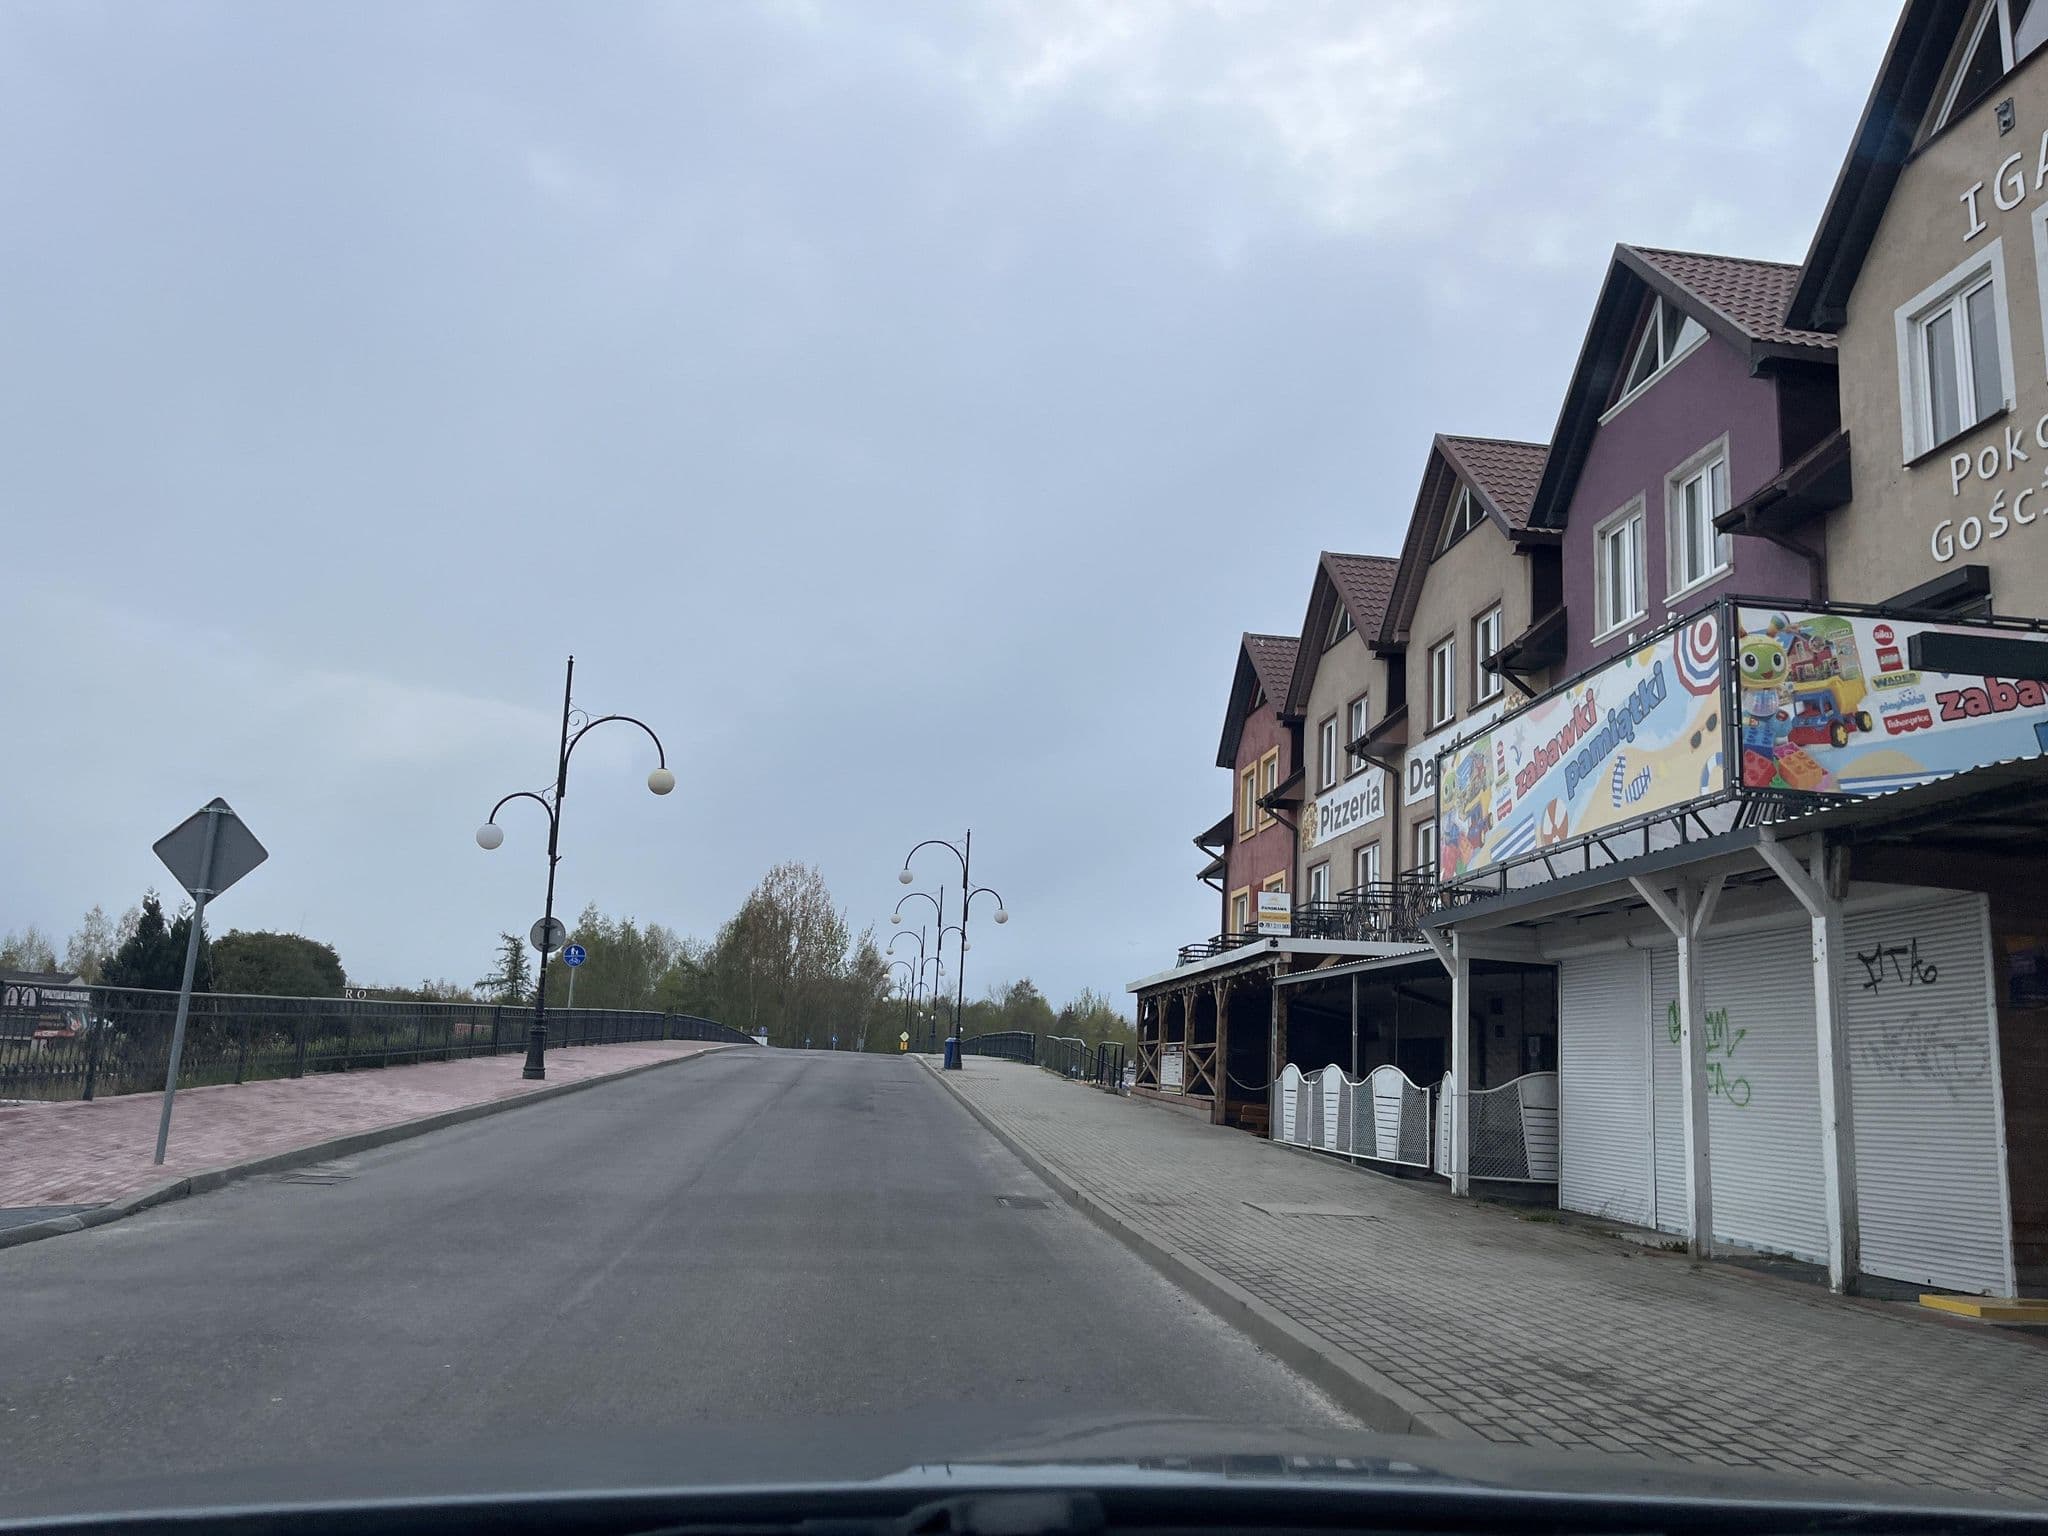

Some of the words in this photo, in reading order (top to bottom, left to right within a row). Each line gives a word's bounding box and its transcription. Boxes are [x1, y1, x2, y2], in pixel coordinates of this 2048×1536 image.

[1565, 660, 1667, 800] pamiątki
[1936, 676, 2048, 721] zaba
[1515, 688, 1597, 800] zabawki
[1320, 779, 1380, 837] Pizzeria
